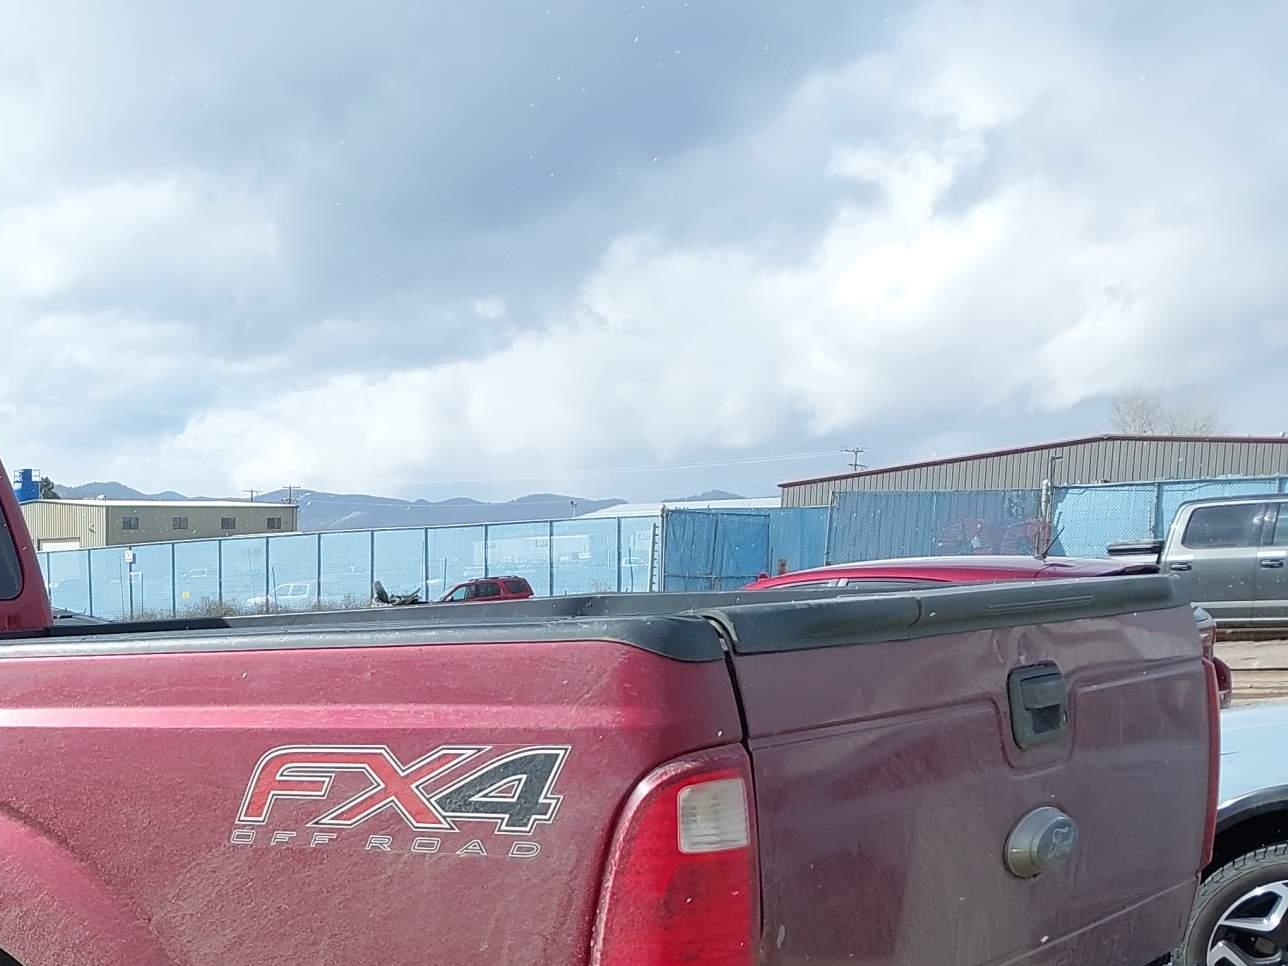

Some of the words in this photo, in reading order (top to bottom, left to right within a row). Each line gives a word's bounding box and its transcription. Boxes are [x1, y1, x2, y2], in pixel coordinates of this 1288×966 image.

[234, 744, 572, 836] FX4
[230, 829, 337, 847] OFF
[365, 835, 541, 858] ROAD
